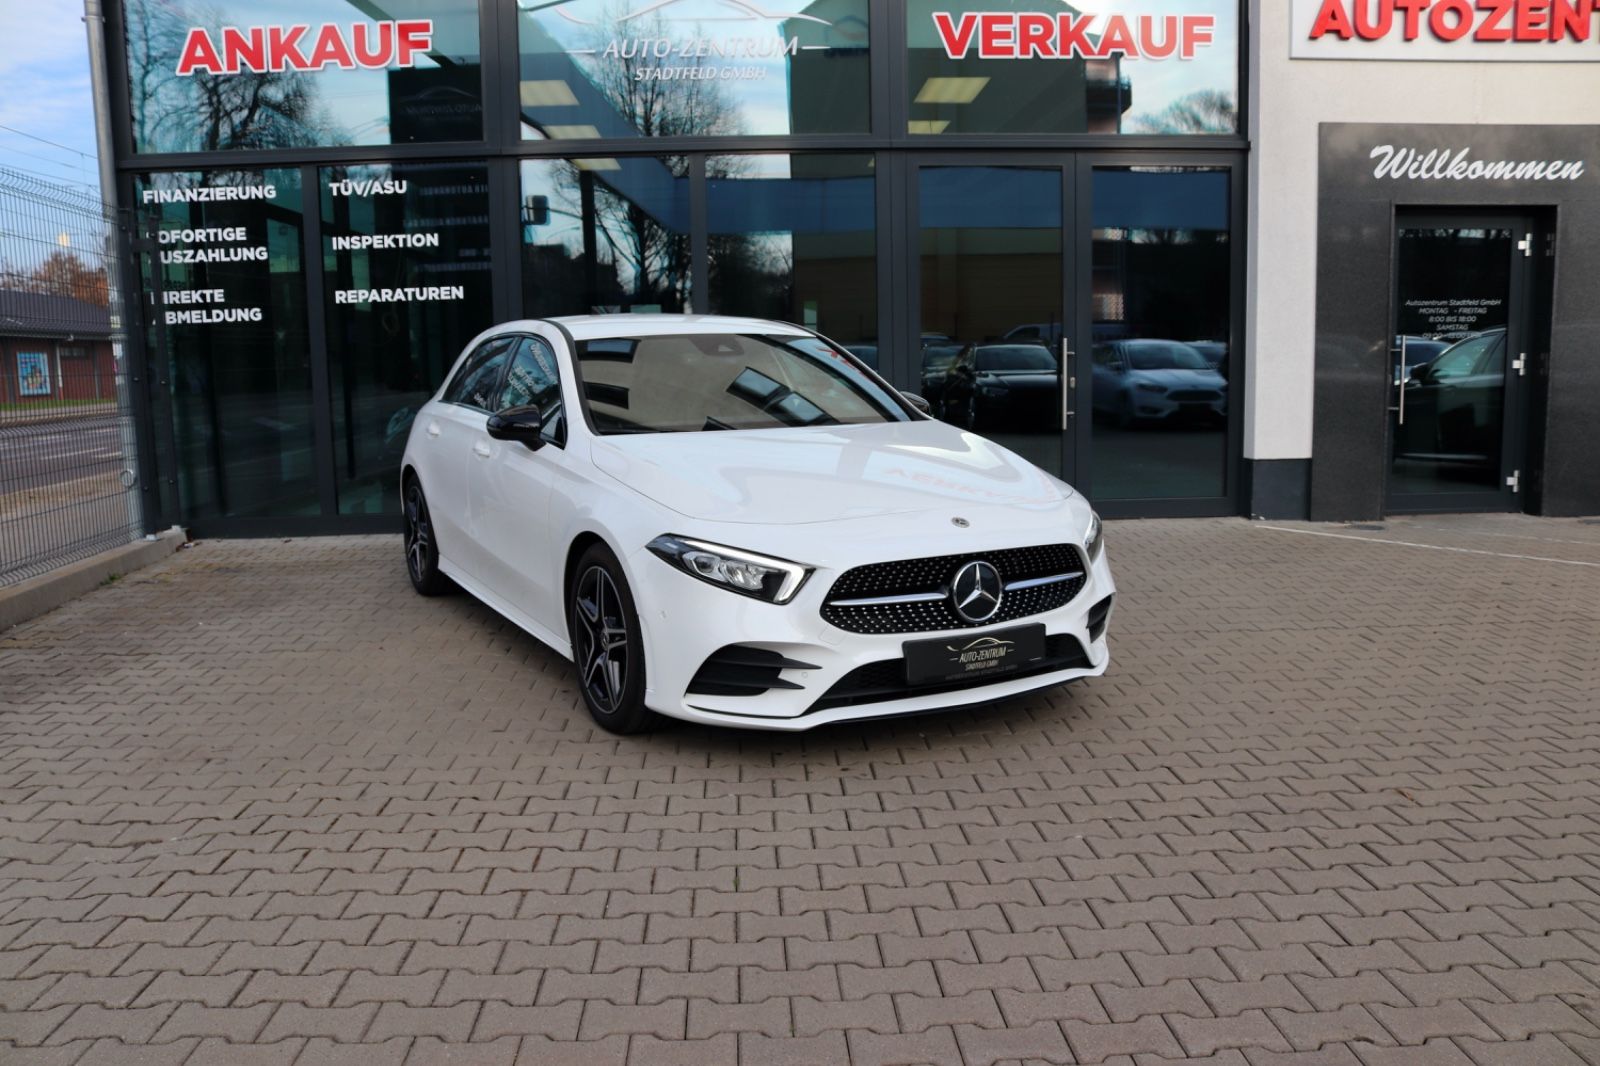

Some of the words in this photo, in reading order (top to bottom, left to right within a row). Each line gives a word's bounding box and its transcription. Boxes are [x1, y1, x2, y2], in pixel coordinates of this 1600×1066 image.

[1307, 0, 1600, 43] AUTOZEN
[933, 12, 1216, 61] VERKAUF
[176, 20, 433, 76] ANKAUF
[603, 36, 799, 59] AUTO-ZENTRUM
[635, 67, 717, 81] STADTFELD
[720, 66, 767, 80] GMBH
[1369, 144, 1585, 180] Willkommen
[143, 185, 277, 204] FINANZIERUNG
[329, 179, 407, 197] TÜV/ASU
[146, 227, 247, 244] OFORTIGE
[332, 233, 439, 250] INSPEKTION
[148, 246, 269, 264] USZAHLUNG
[151, 289, 225, 304] IREKTE
[335, 286, 465, 304] REPARATUREN
[152, 307, 263, 324] BMELDUNG
[1419, 307, 1449, 315] MONTAG
[1458, 307, 1487, 315] FREITAG
[1436, 323, 1469, 331] SAMSTAG
[959, 646, 1007, 663] AUTO-ZENTRUM
